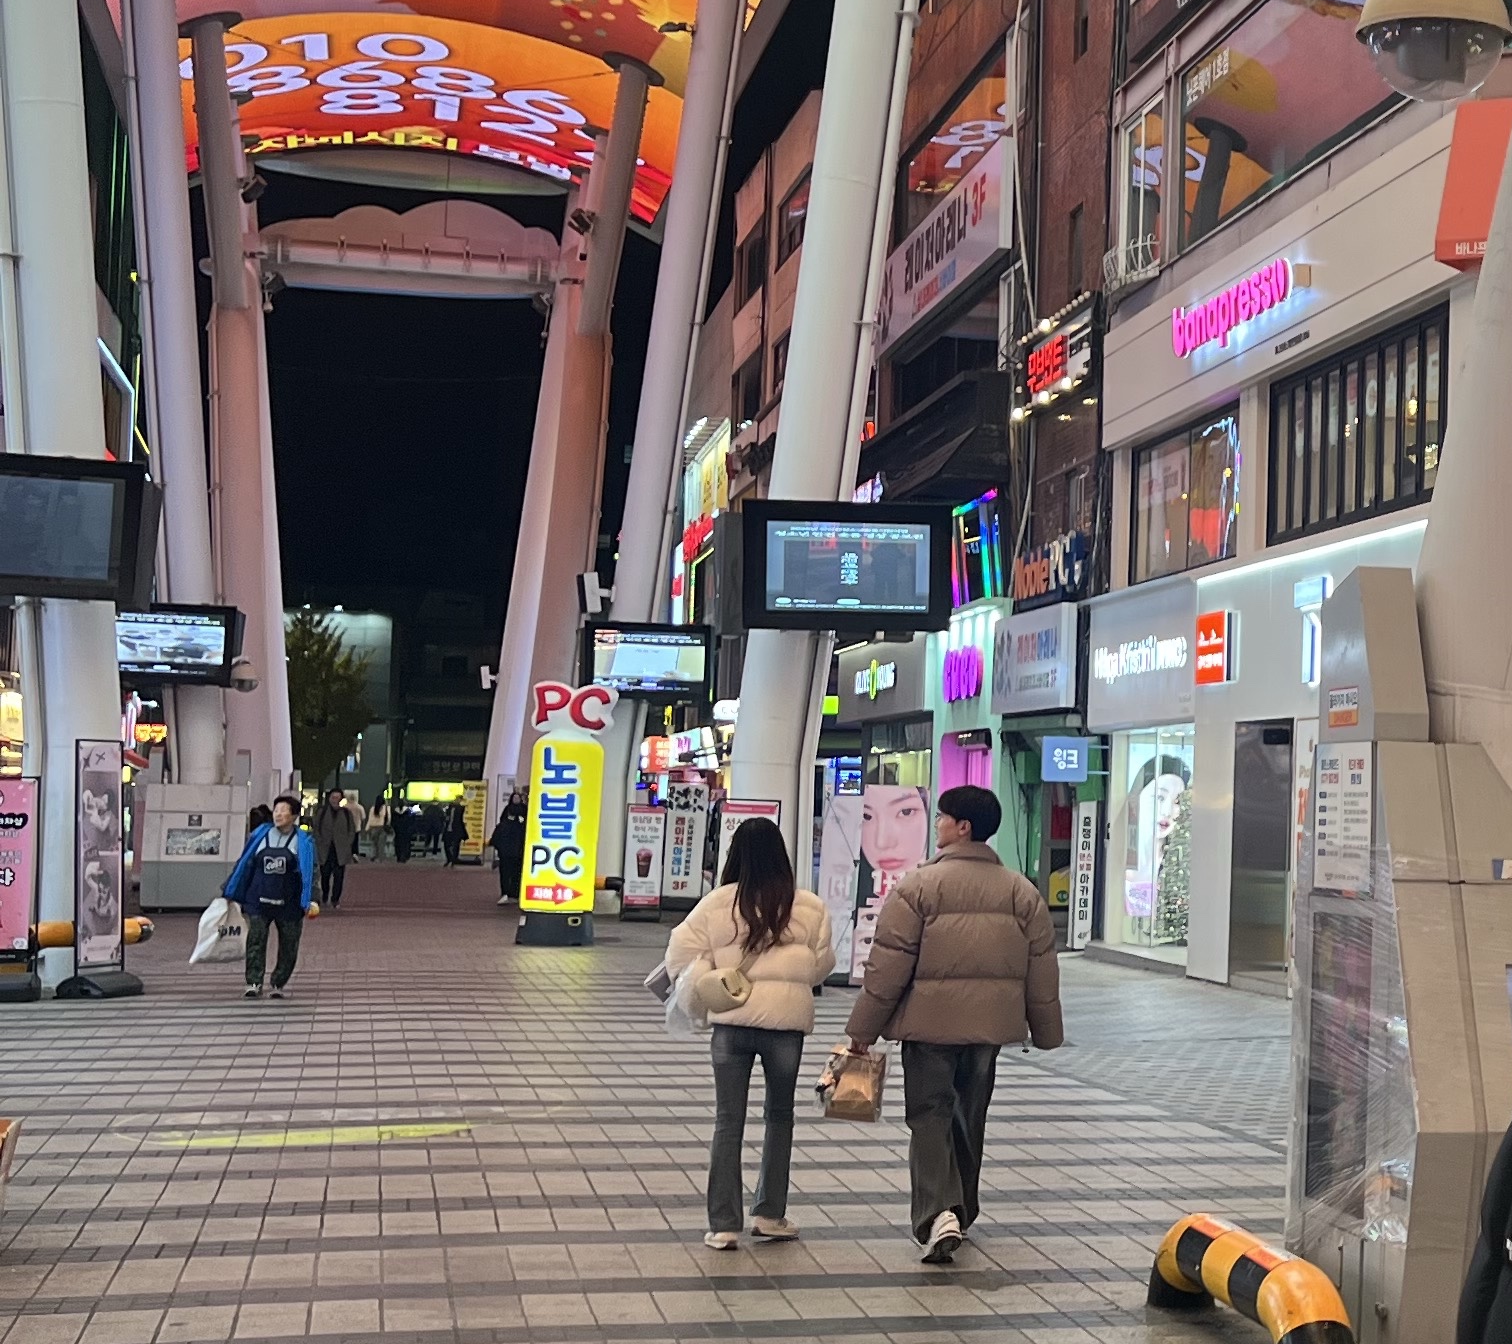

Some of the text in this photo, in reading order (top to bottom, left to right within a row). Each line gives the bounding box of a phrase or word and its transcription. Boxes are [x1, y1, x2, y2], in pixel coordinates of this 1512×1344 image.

[904, 186, 969, 294] 레이저아레나
[971, 172, 988, 228] 3F
[1172, 257, 1293, 359] banapresso
[534, 685, 611, 731] PC
[1052, 747, 1080, 770] 윙크
[538, 746, 578, 840] 노블
[530, 844, 581, 876] PC
[671, 880, 688, 891] 3F
[1078, 872, 1090, 921] 아카데미
